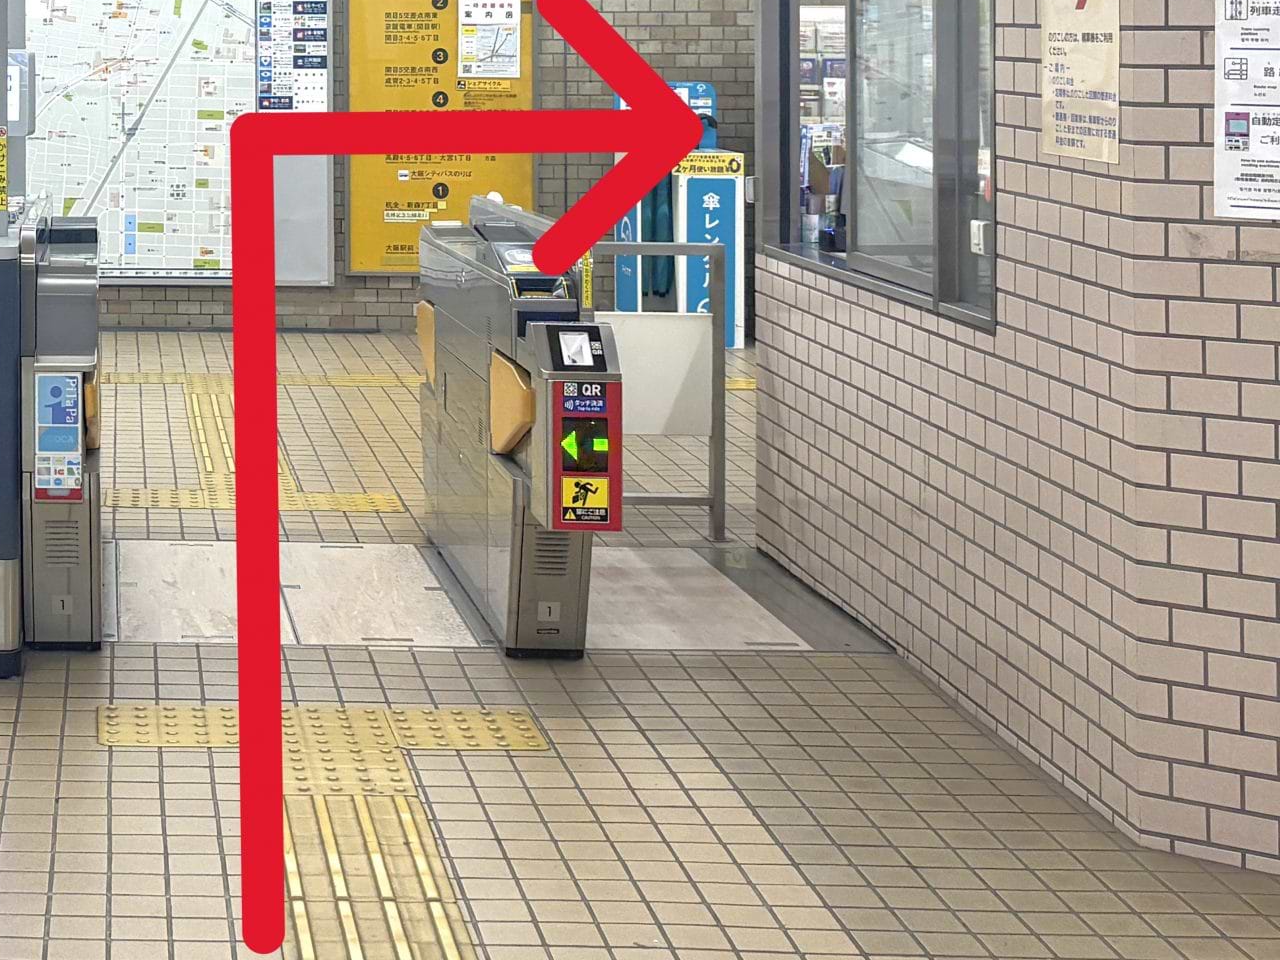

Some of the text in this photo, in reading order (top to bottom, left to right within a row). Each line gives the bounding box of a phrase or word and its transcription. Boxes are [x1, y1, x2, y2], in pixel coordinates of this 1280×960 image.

[1252, 116, 1280, 126] 自動定
[582, 384, 601, 396] QR
[66, 379, 77, 423] PiTaPa
